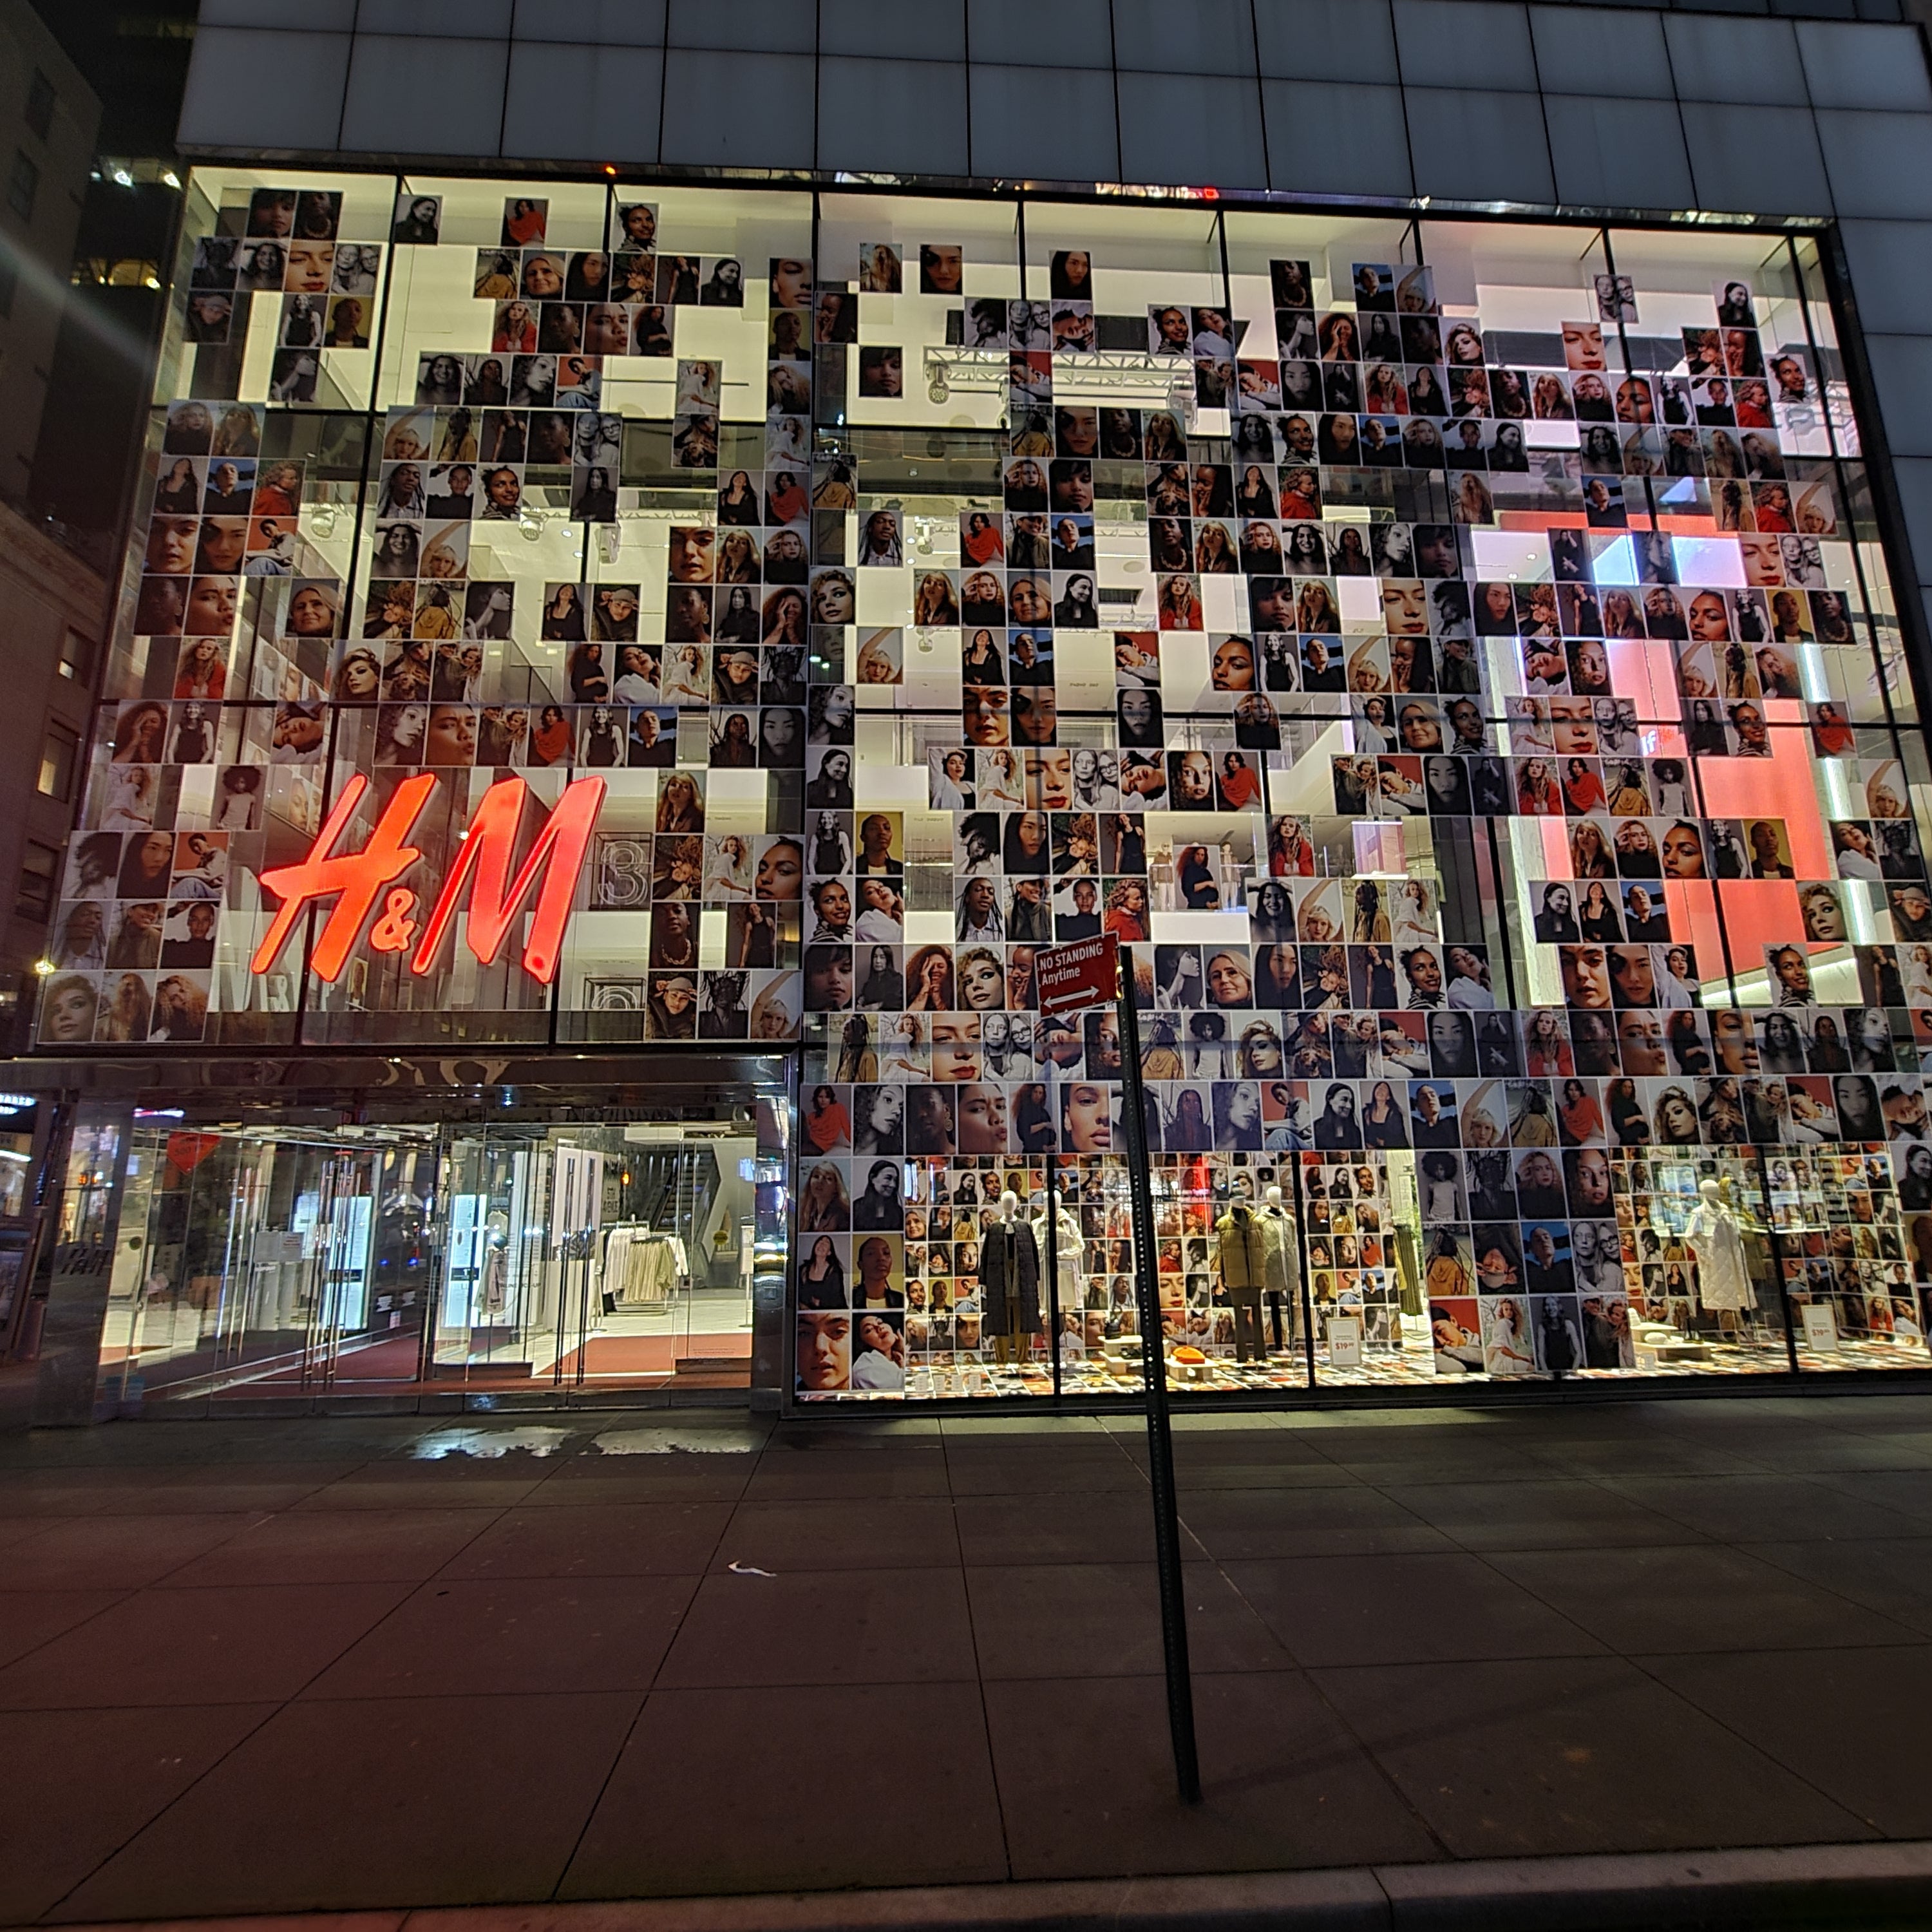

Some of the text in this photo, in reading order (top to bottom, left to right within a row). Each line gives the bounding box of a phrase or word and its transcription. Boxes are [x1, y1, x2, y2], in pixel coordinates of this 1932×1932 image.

[252, 773, 606, 983] H&M
[1039, 942, 1103, 971] NO STANDING
[1041, 967, 1081, 986] Anytime
